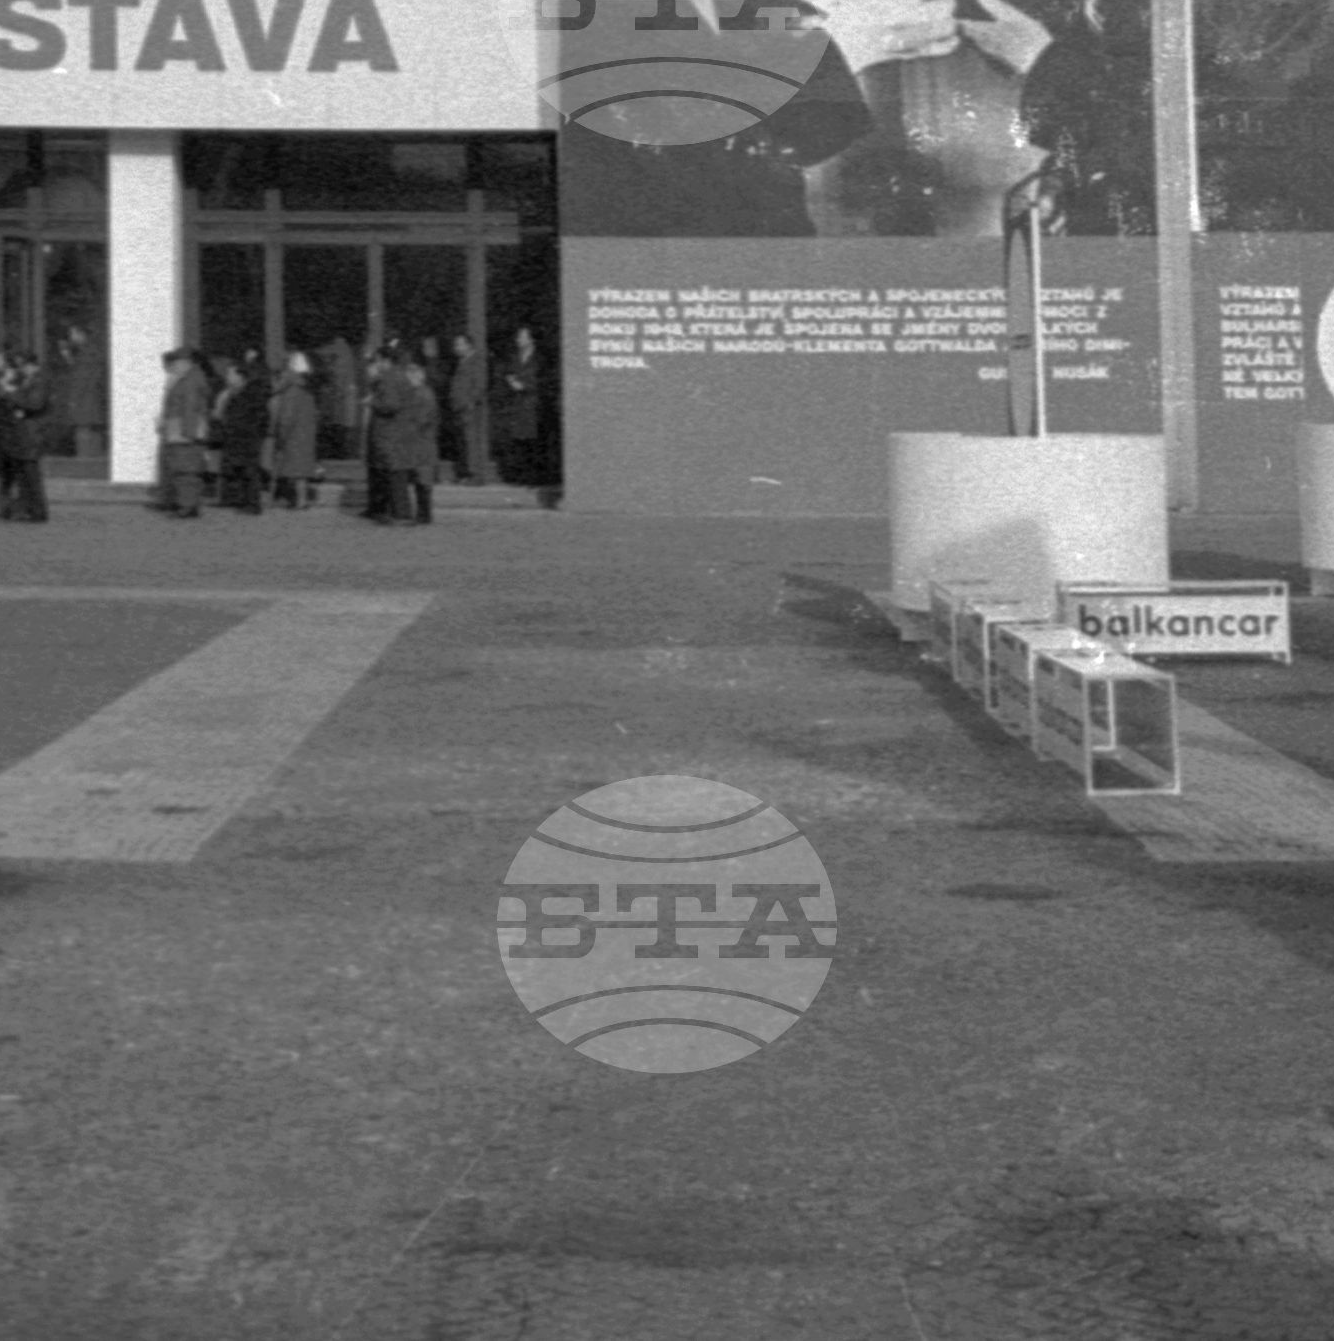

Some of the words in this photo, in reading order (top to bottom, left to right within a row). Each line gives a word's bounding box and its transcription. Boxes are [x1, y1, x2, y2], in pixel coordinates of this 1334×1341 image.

[868, 289, 880, 303] A
[1101, 288, 1124, 302] JE
[665, 306, 678, 320] O
[904, 307, 916, 320] A
[753, 322, 776, 336] JE
[1077, 603, 1279, 637] balkancar
